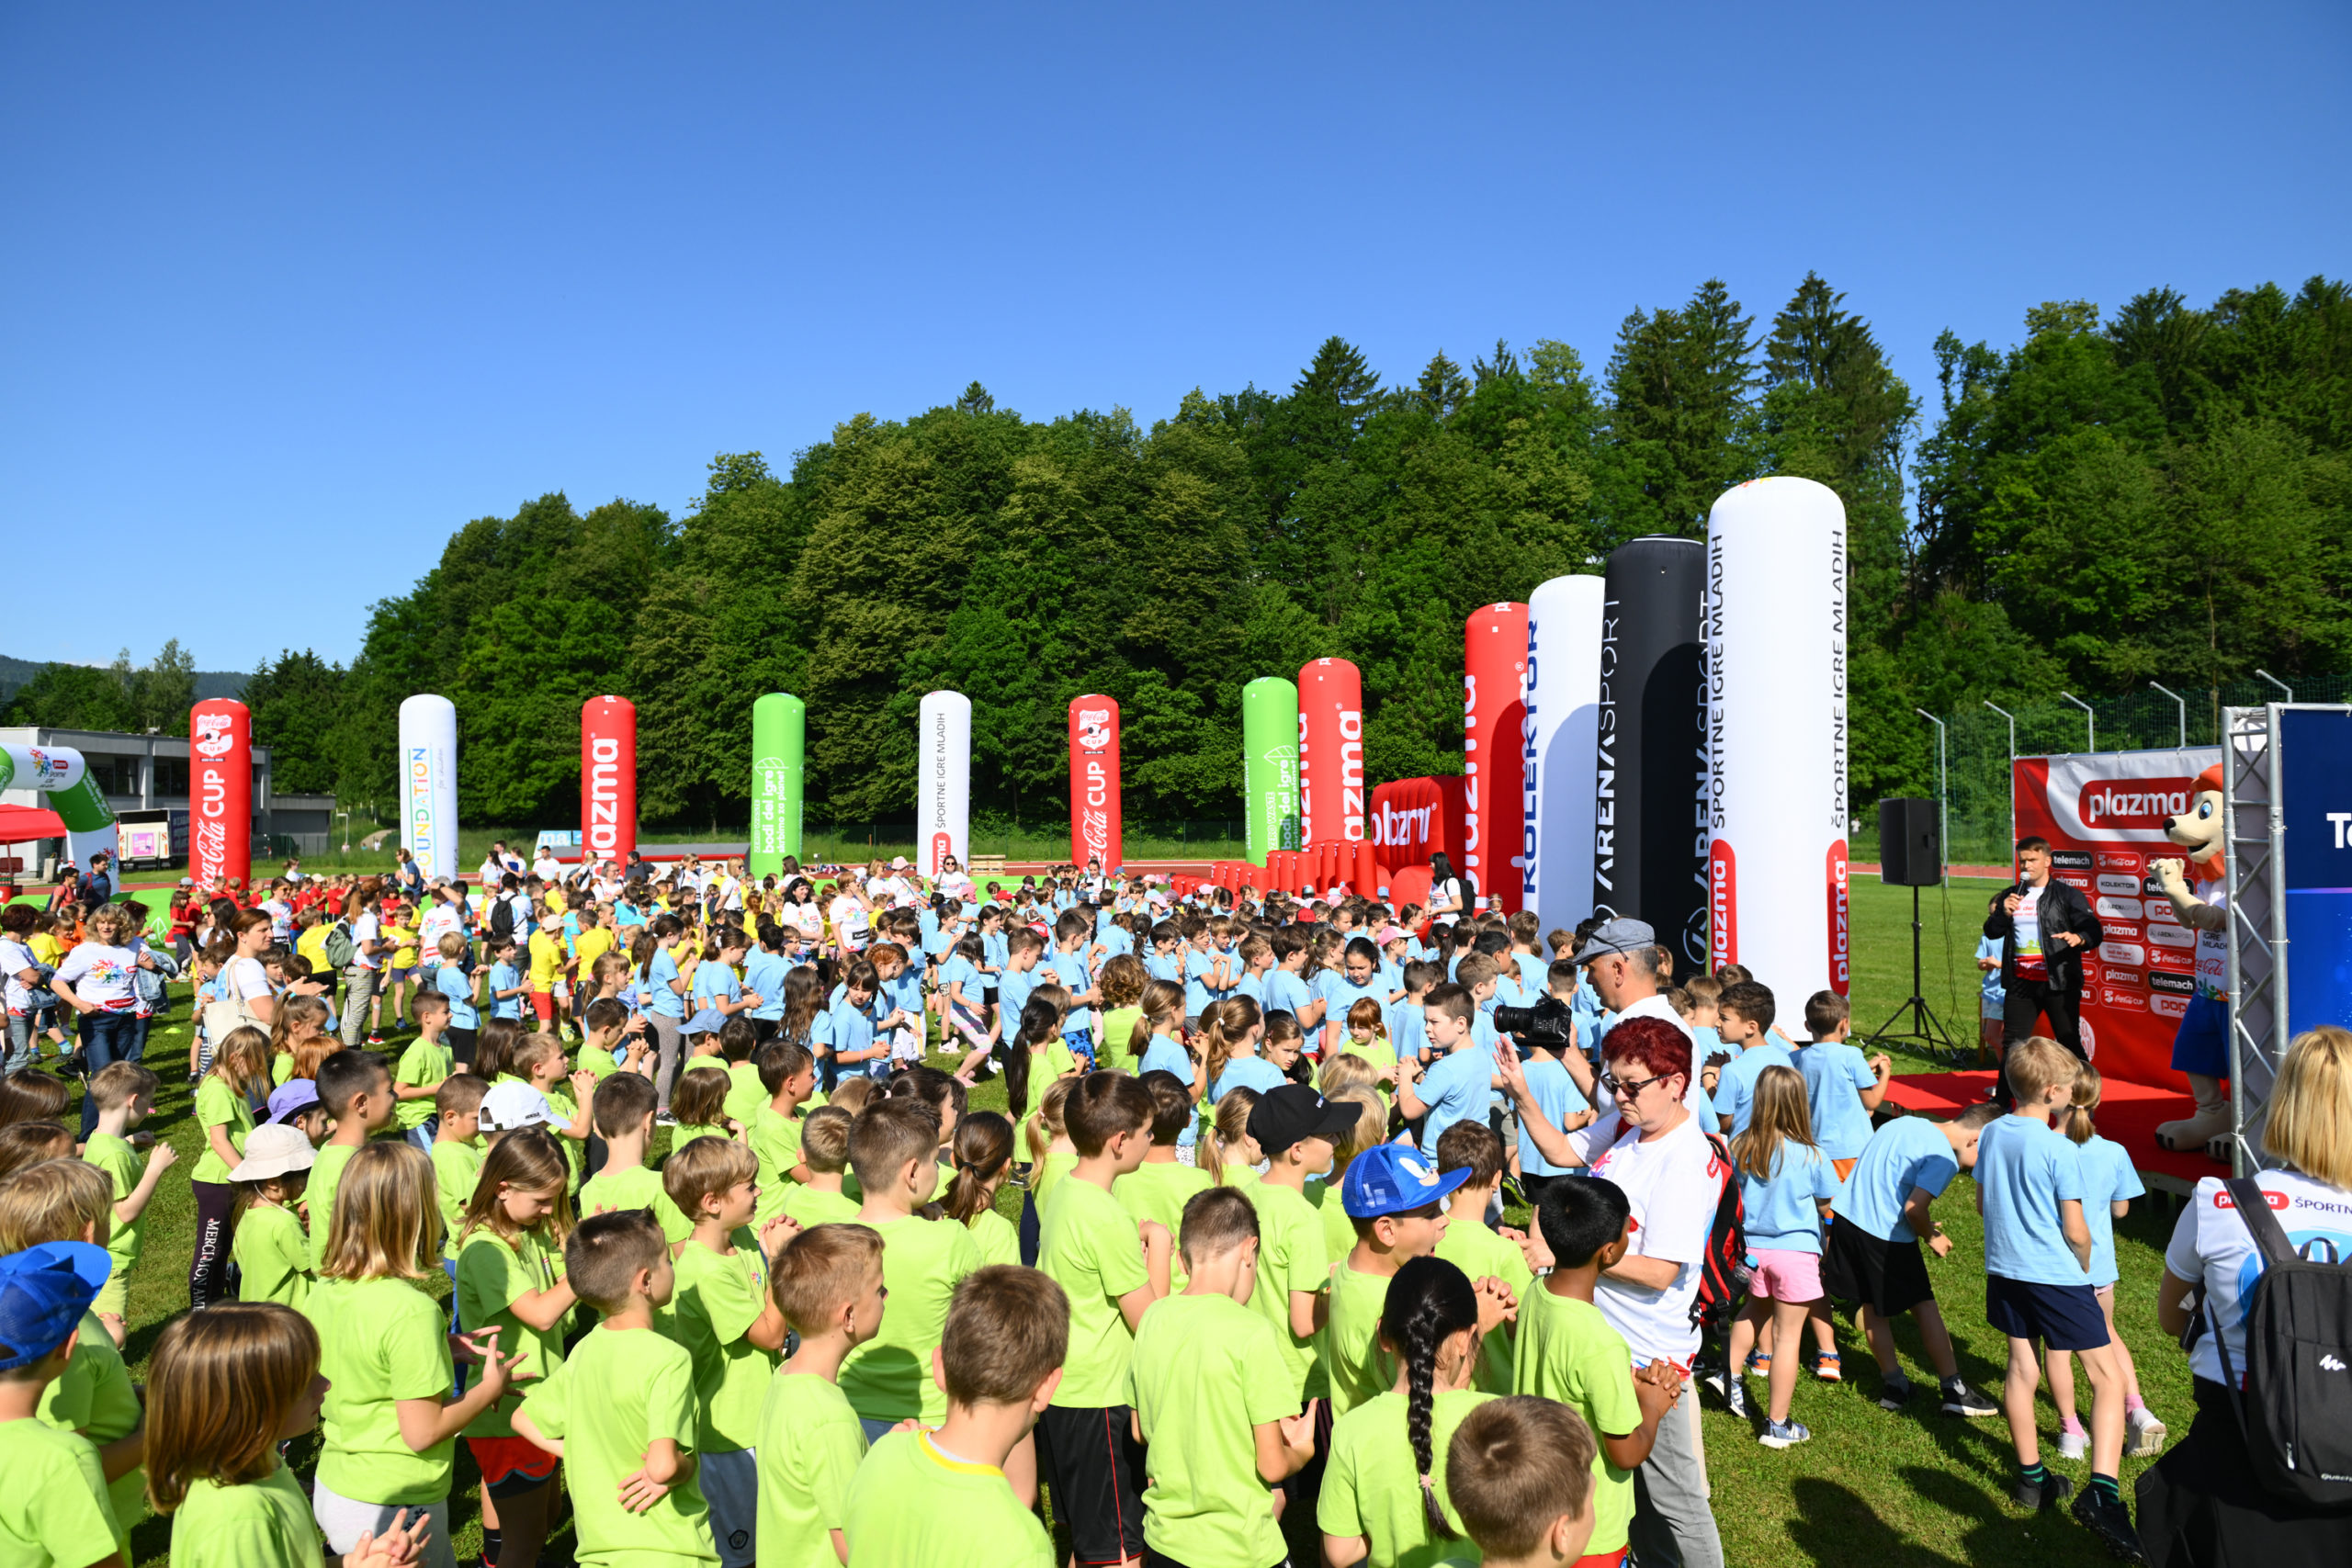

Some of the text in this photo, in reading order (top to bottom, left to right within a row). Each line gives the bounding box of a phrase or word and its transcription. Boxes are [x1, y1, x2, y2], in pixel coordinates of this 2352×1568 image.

[1711, 535, 1725, 829] ŠPORTNE IGRE MLADIH
[1831, 530, 1845, 829] ŠPORTNE IGRE MLADIH
[934, 713, 946, 829] ŠPORTNE IGRE MLADIH
[1523, 619, 1537, 895] KOLEKTOR
[202, 769, 225, 818] CUP
[1087, 761, 1106, 807] CUP
[762, 770, 777, 854] bodi del igre
[1277, 759, 1292, 851] bodi del igre
[2088, 787, 2187, 823] plazma
[2326, 813, 2352, 849] T
[2053, 855, 2090, 865] telemach
[2100, 881, 2135, 889] KOLEKTOR
[1833, 860, 1849, 983] plazma
[2102, 924, 2138, 936] plazma
[2202, 931, 2221, 942] IGRE
[2106, 968, 2139, 983] plazma
[2151, 976, 2194, 990] telemach
[201, 1219, 220, 1257] MERCI
[193, 1257, 213, 1286] MON
